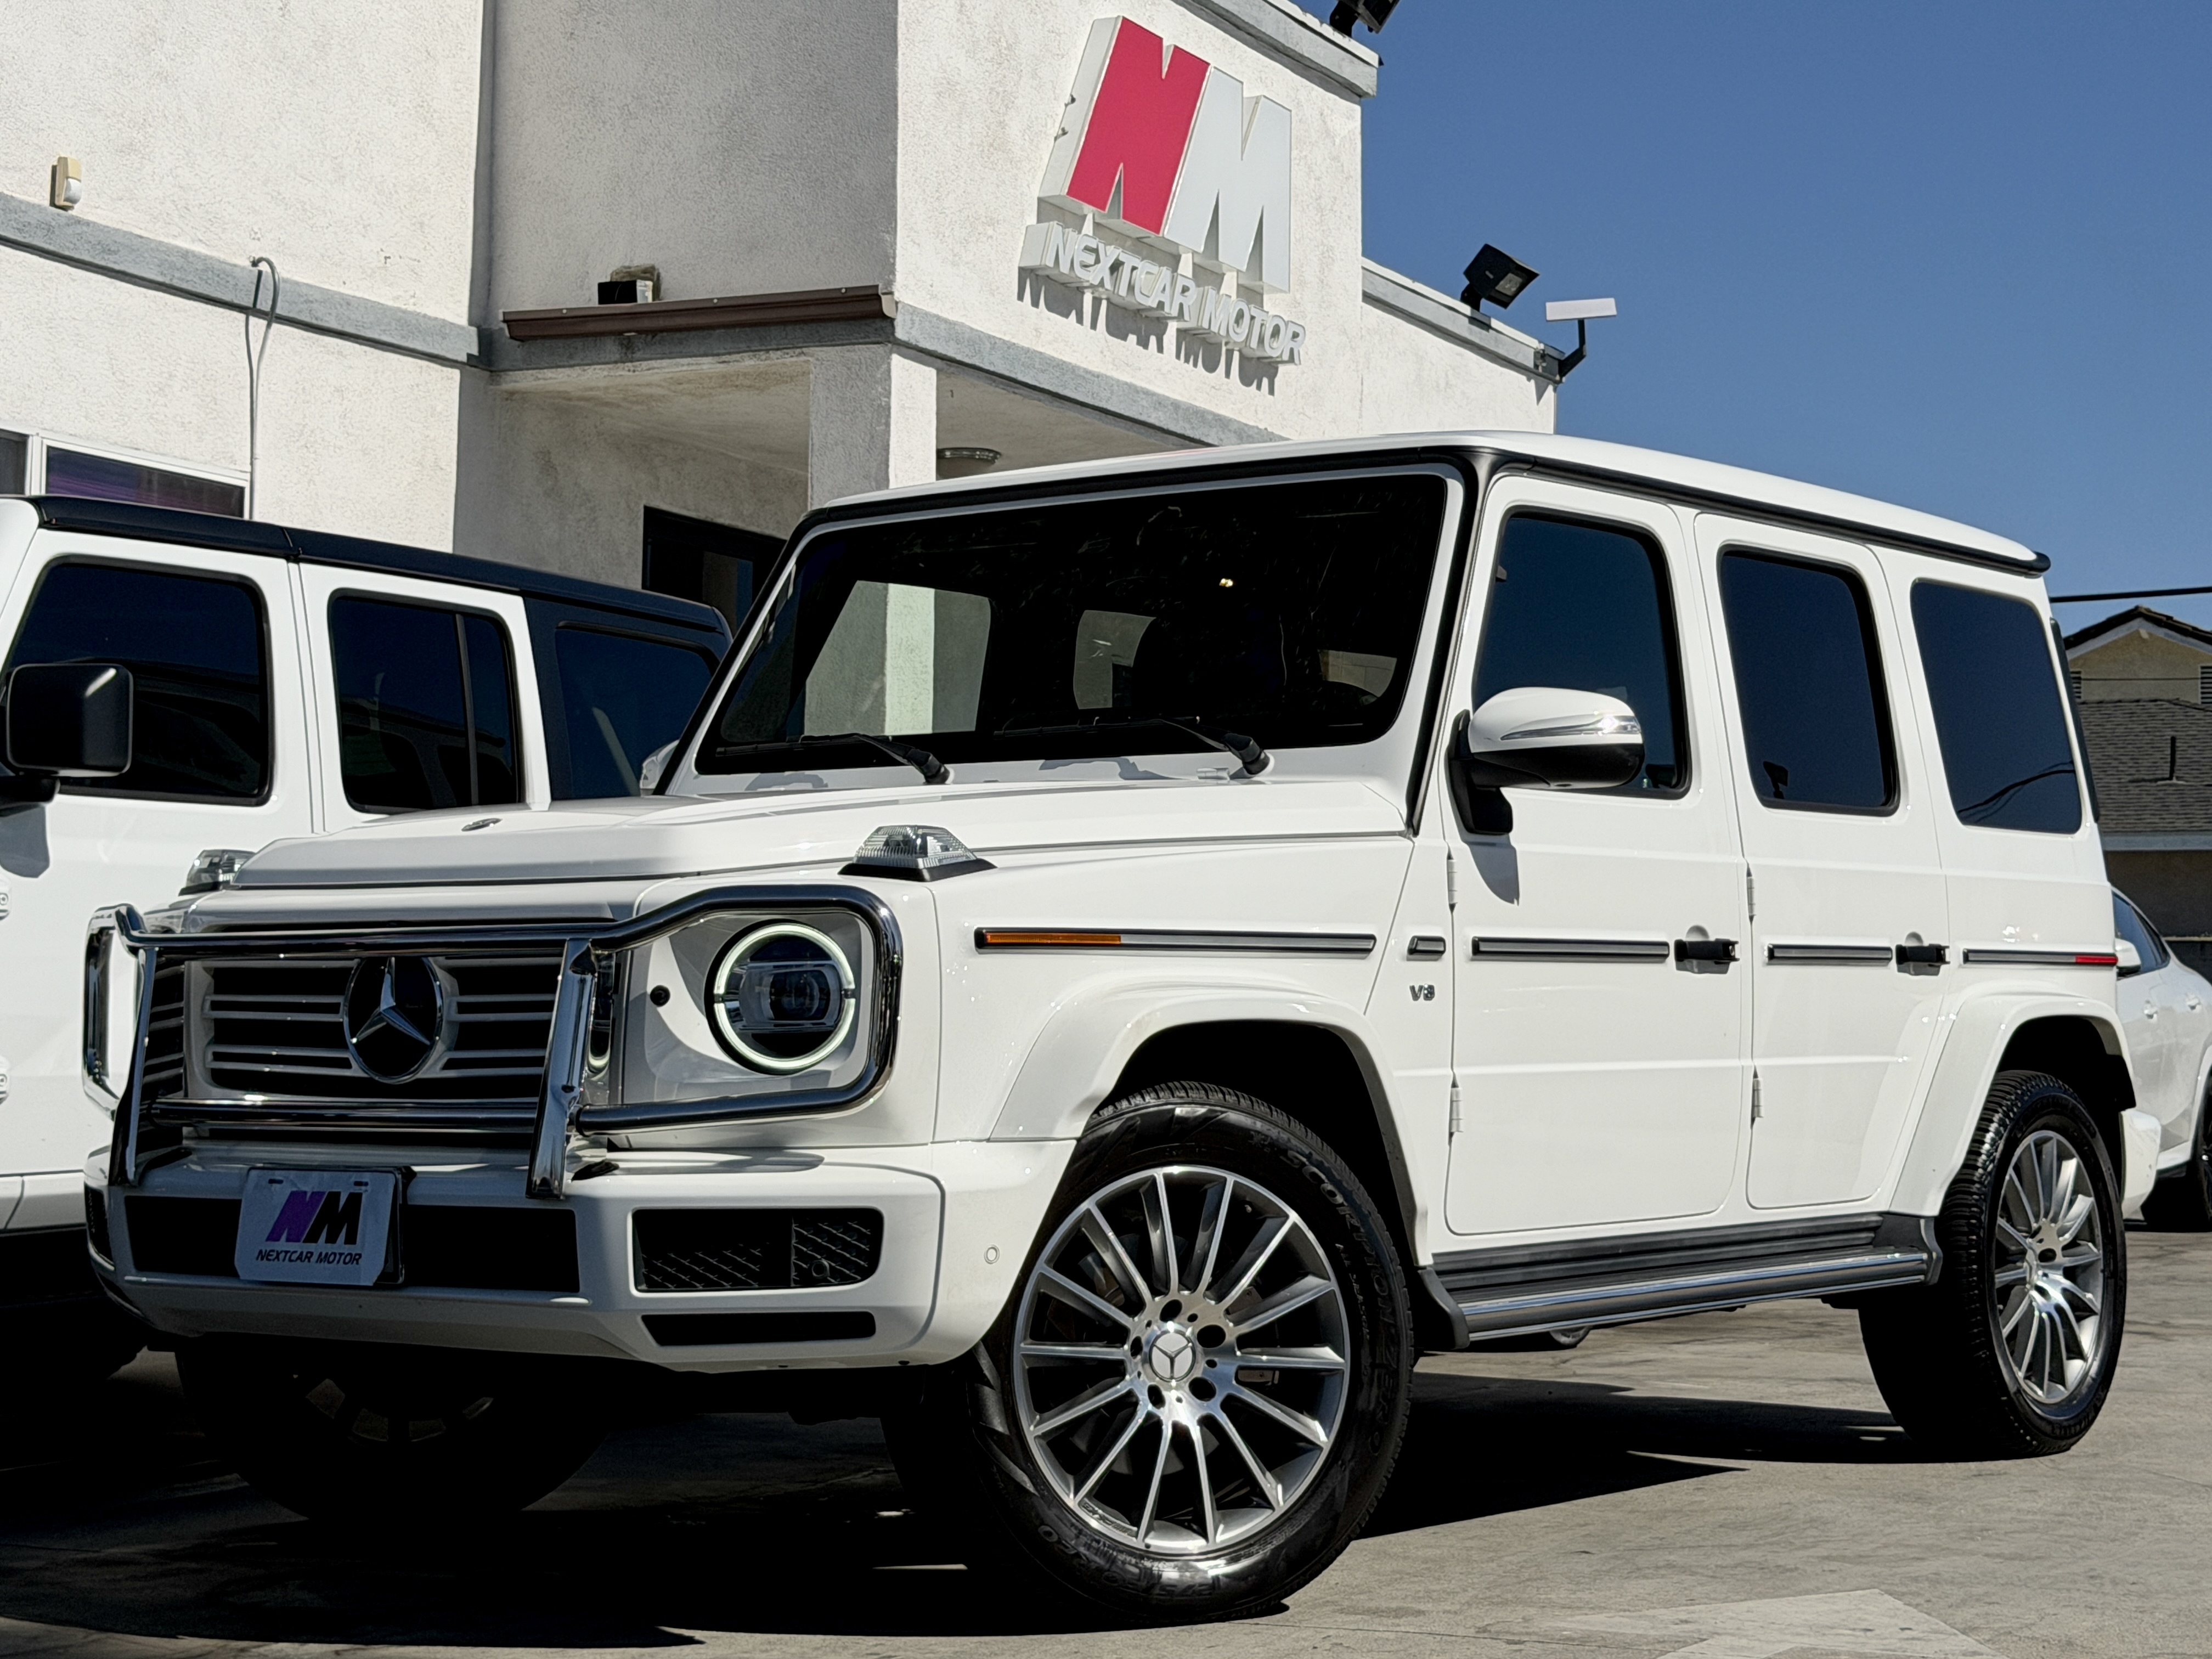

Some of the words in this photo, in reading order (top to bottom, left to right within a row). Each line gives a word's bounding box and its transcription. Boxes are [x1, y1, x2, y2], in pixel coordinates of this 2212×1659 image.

[1066, 15, 1291, 293] NM
[1045, 222, 1196, 321] NEXTCAR
[1201, 286, 1306, 365] MOTOR
[1409, 984, 1435, 1002] V8
[265, 1190, 363, 1245] NM
[256, 1249, 313, 1263] NEXTCAR
[315, 1251, 362, 1265] MOTOR
